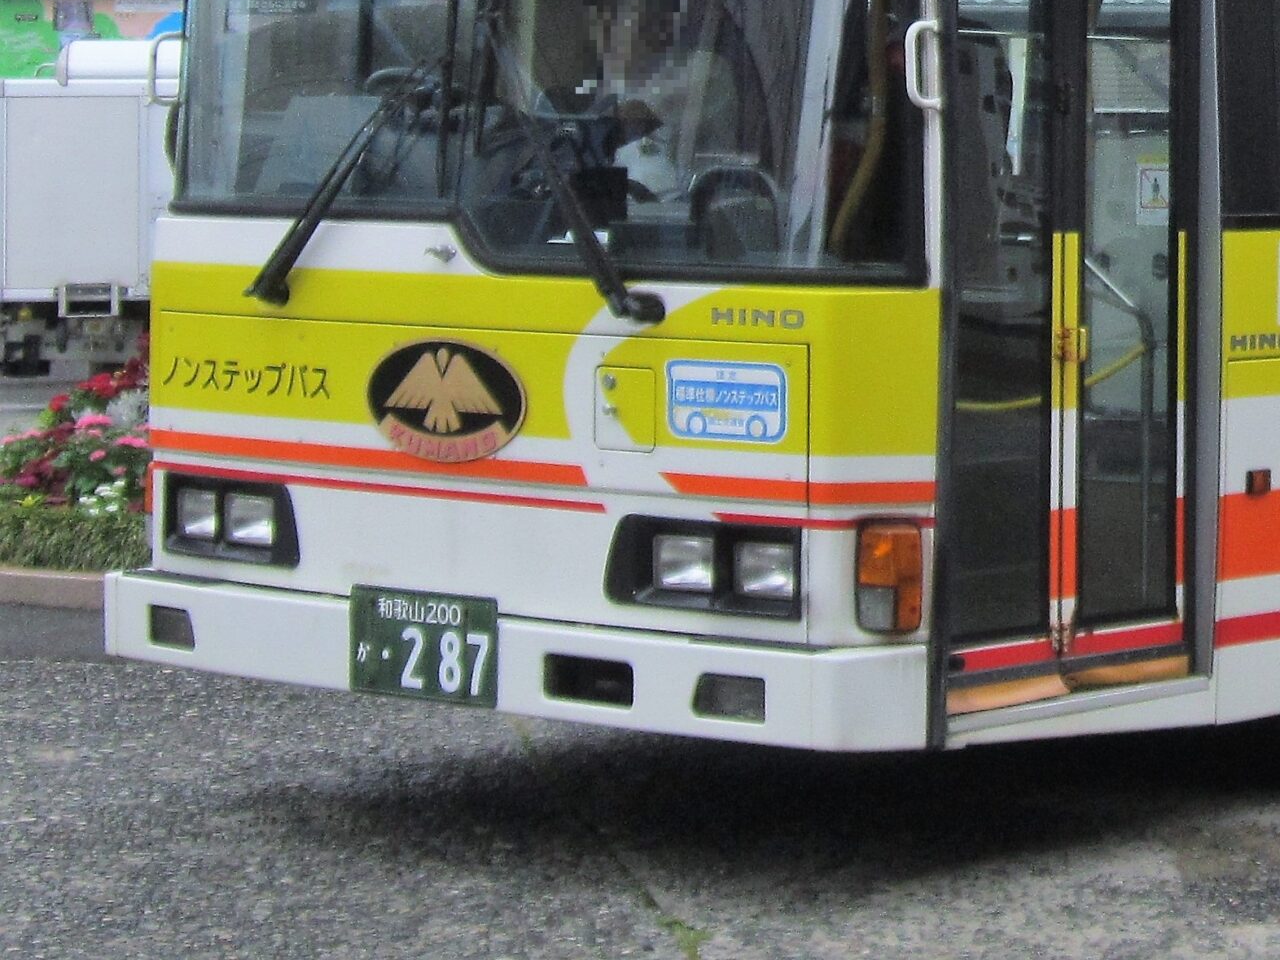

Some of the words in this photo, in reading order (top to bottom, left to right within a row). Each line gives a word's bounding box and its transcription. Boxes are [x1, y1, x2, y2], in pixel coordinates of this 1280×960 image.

[711, 307, 805, 329] HINO
[162, 356, 330, 400] ノンステップバス
[377, 597, 461, 626] 和歌山200
